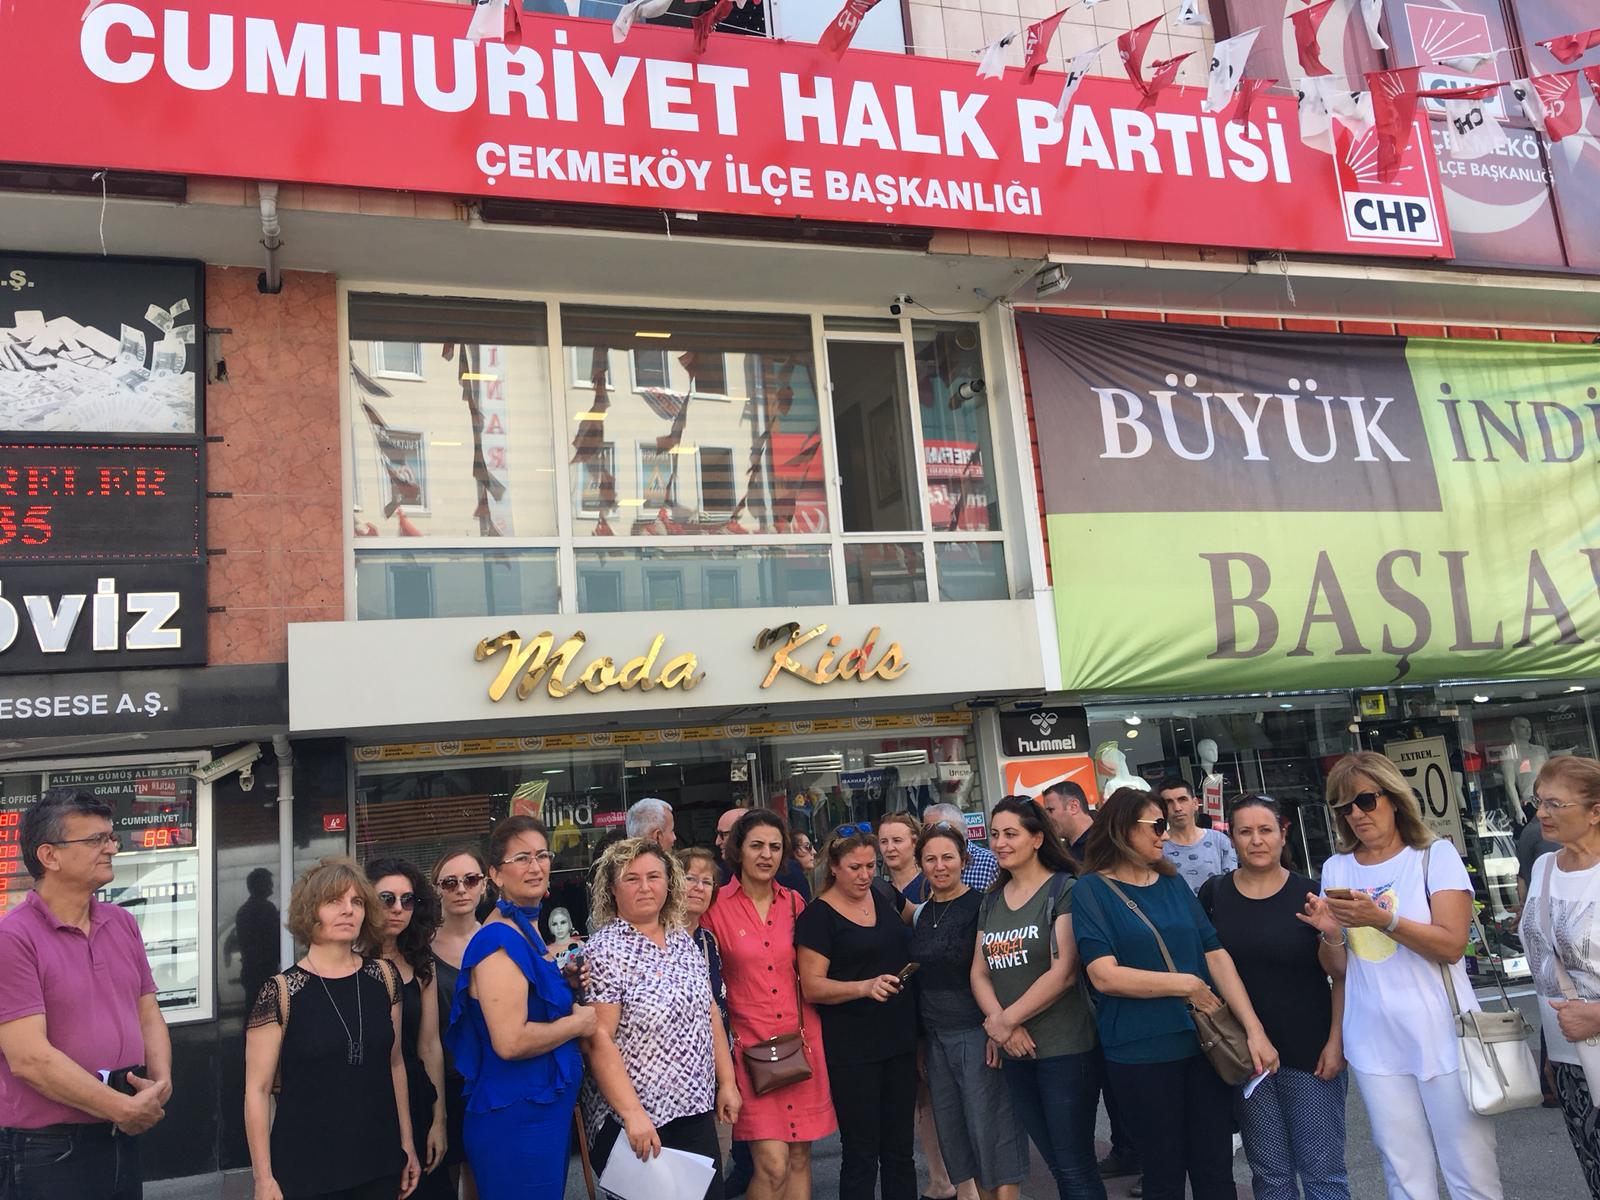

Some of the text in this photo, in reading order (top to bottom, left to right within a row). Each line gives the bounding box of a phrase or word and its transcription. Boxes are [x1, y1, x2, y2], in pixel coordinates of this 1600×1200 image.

[80, 3, 1292, 183] CUMHURİYET HALK PARTİSİ
[476, 142, 1043, 216] ÇEKMEKÖY İLÇE BAŞKANLIĞI
[1354, 198, 1426, 233] CHP
[1090, 373, 1411, 462] BÜYÜK
[473, 621, 910, 702] Moda Kids
[115, 692, 169, 717] A.Ş.
[1018, 734, 1076, 753] hummel
[1401, 749, 1432, 761] EXTREM
[52, 774, 82, 784] ALTIN
[97, 770, 133, 781] GÜMÜŞ
[8, 795, 37, 804] OFFICE
[94, 785, 120, 796] GRAM
[121, 813, 179, 826] CUMHURİYET
[987, 949, 1029, 970] PRIVET
